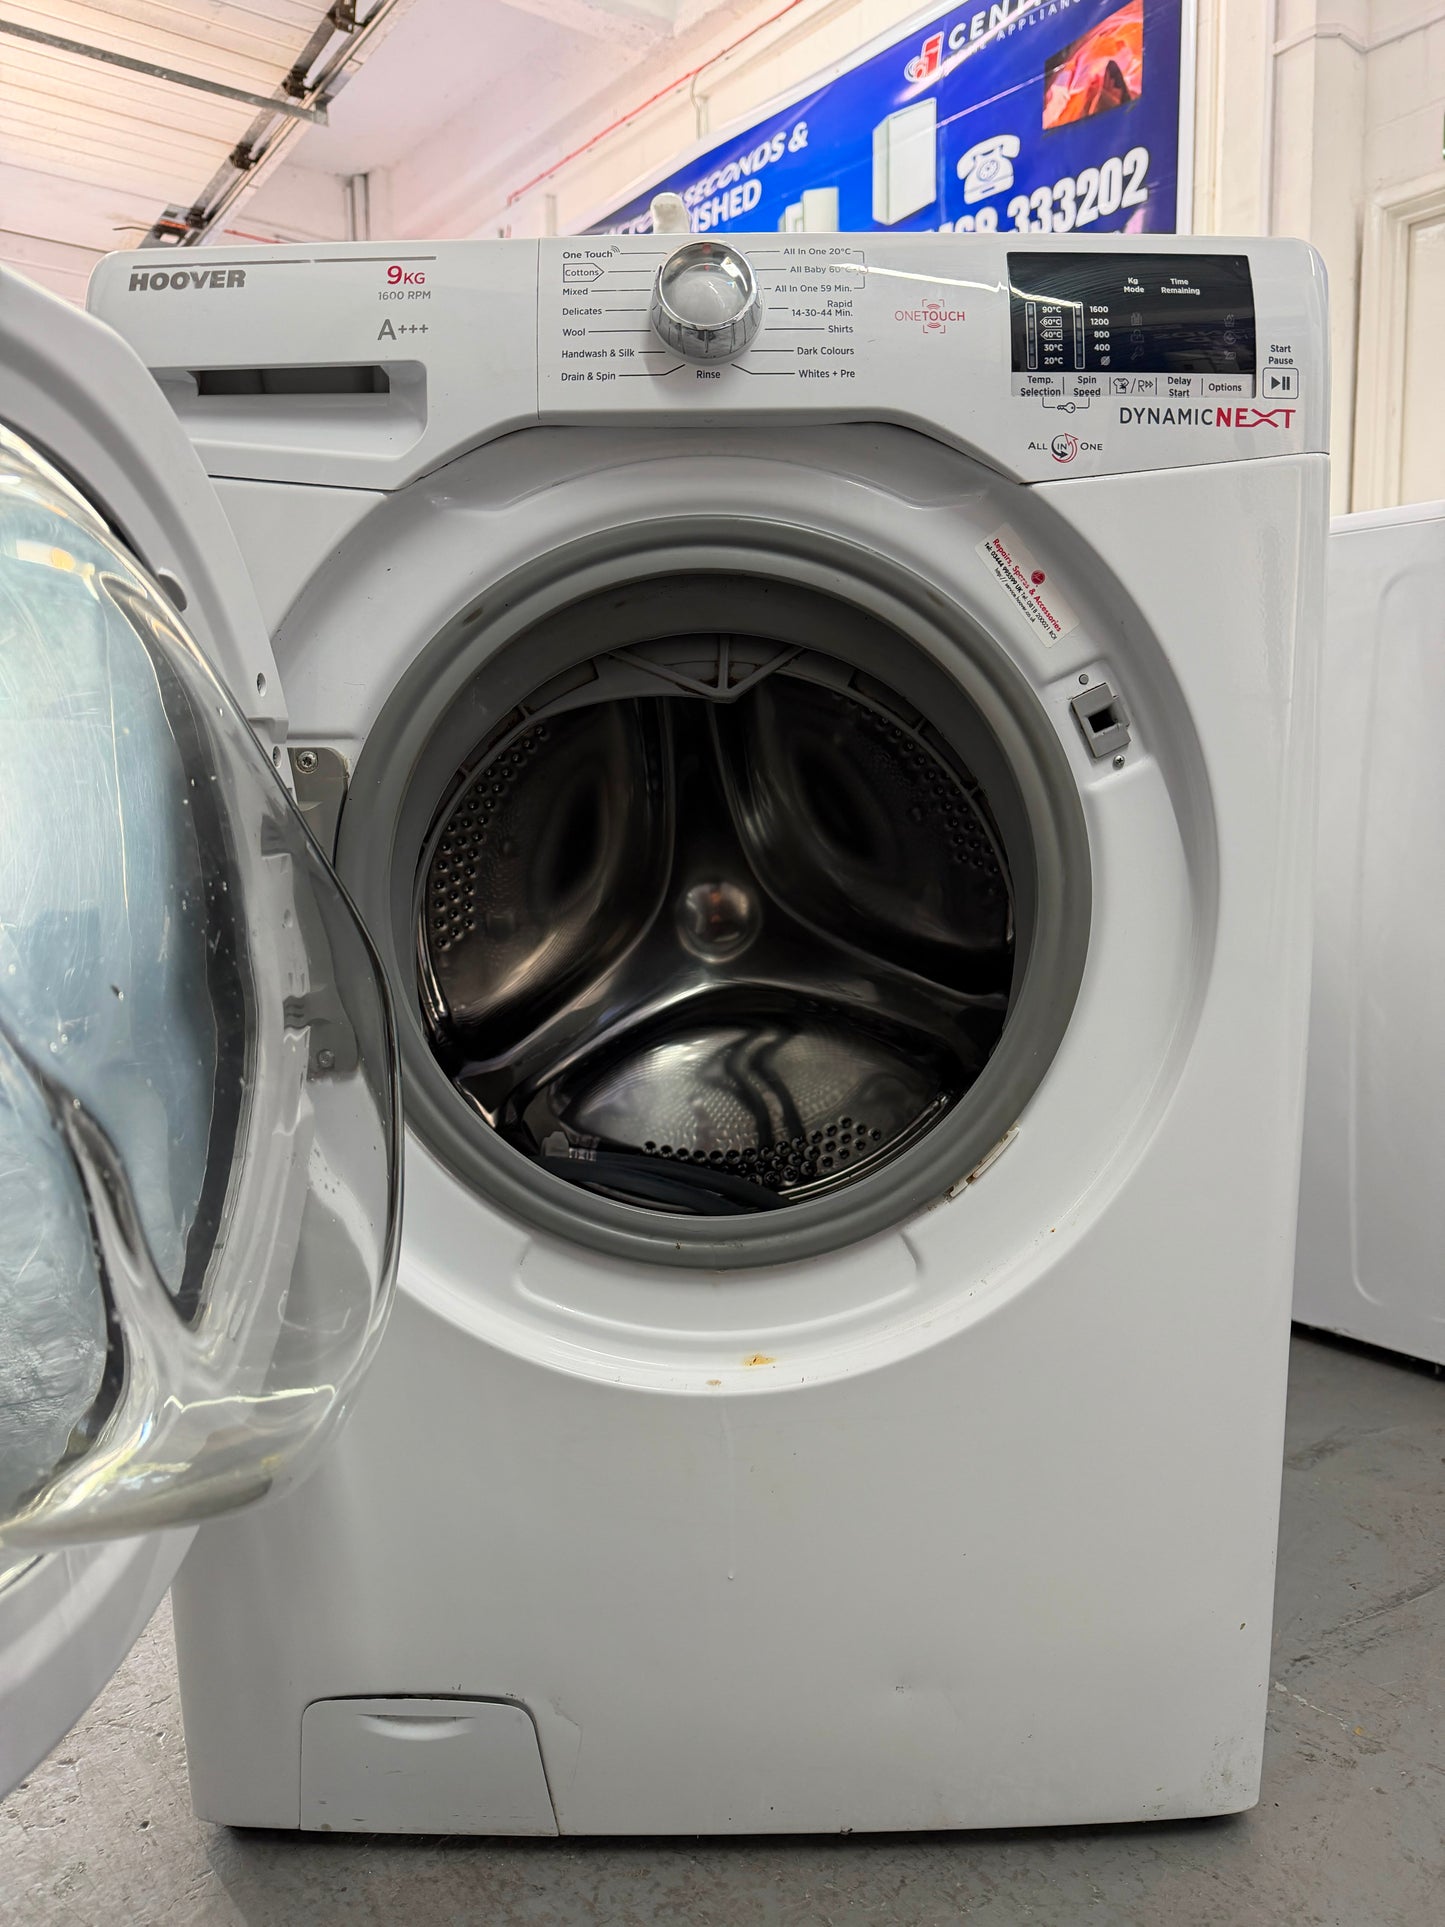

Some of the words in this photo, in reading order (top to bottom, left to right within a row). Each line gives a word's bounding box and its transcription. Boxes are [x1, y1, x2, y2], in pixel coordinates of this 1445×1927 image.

[683, 131, 787, 206] SECONDS
[788, 121, 809, 152] &
[1007, 146, 1150, 233] 333202
[691, 178, 762, 233] ISHED
[563, 251, 582, 259] One
[585, 250, 613, 259] Touch
[565, 269, 600, 277] Cottons
[804, 266, 827, 274] Baby
[387, 265, 426, 285] 9KG
[128, 269, 246, 291] HOOVER
[378, 291, 404, 301] 1600
[408, 290, 431, 300] RPM
[562, 288, 588, 296] Mixed
[1161, 287, 1200, 295] Remaining
[827, 300, 853, 309] Rapid
[894, 310, 965, 321] ONETOUCH
[377, 319, 429, 341] A+++
[562, 328, 586, 336] Wool
[828, 325, 854, 333] Shirts
[561, 349, 607, 358] Handwash
[609, 349, 616, 357] &
[618, 348, 635, 357] Silk
[797, 346, 818, 355] Dark
[820, 346, 855, 355] Colours
[1270, 345, 1292, 353] Start
[1268, 357, 1294, 365] Pause
[561, 372, 585, 381] Drain
[587, 372, 594, 381] &
[596, 372, 616, 382] Spin
[696, 370, 721, 379] Rinse
[798, 369, 830, 378] Whites
[840, 369, 856, 378] Pre
[1027, 376, 1054, 384] Temp.
[1077, 376, 1096, 385] Spin
[1167, 376, 1192, 386] Delay
[1208, 383, 1242, 392] Options
[1020, 388, 1061, 397] Selection
[1073, 388, 1101, 398] Speed
[1168, 389, 1190, 398] Start
[993, 538, 1012, 566] Repairs,
[1029, 588, 1036, 596] &
[1034, 595, 1061, 632] Accessories
